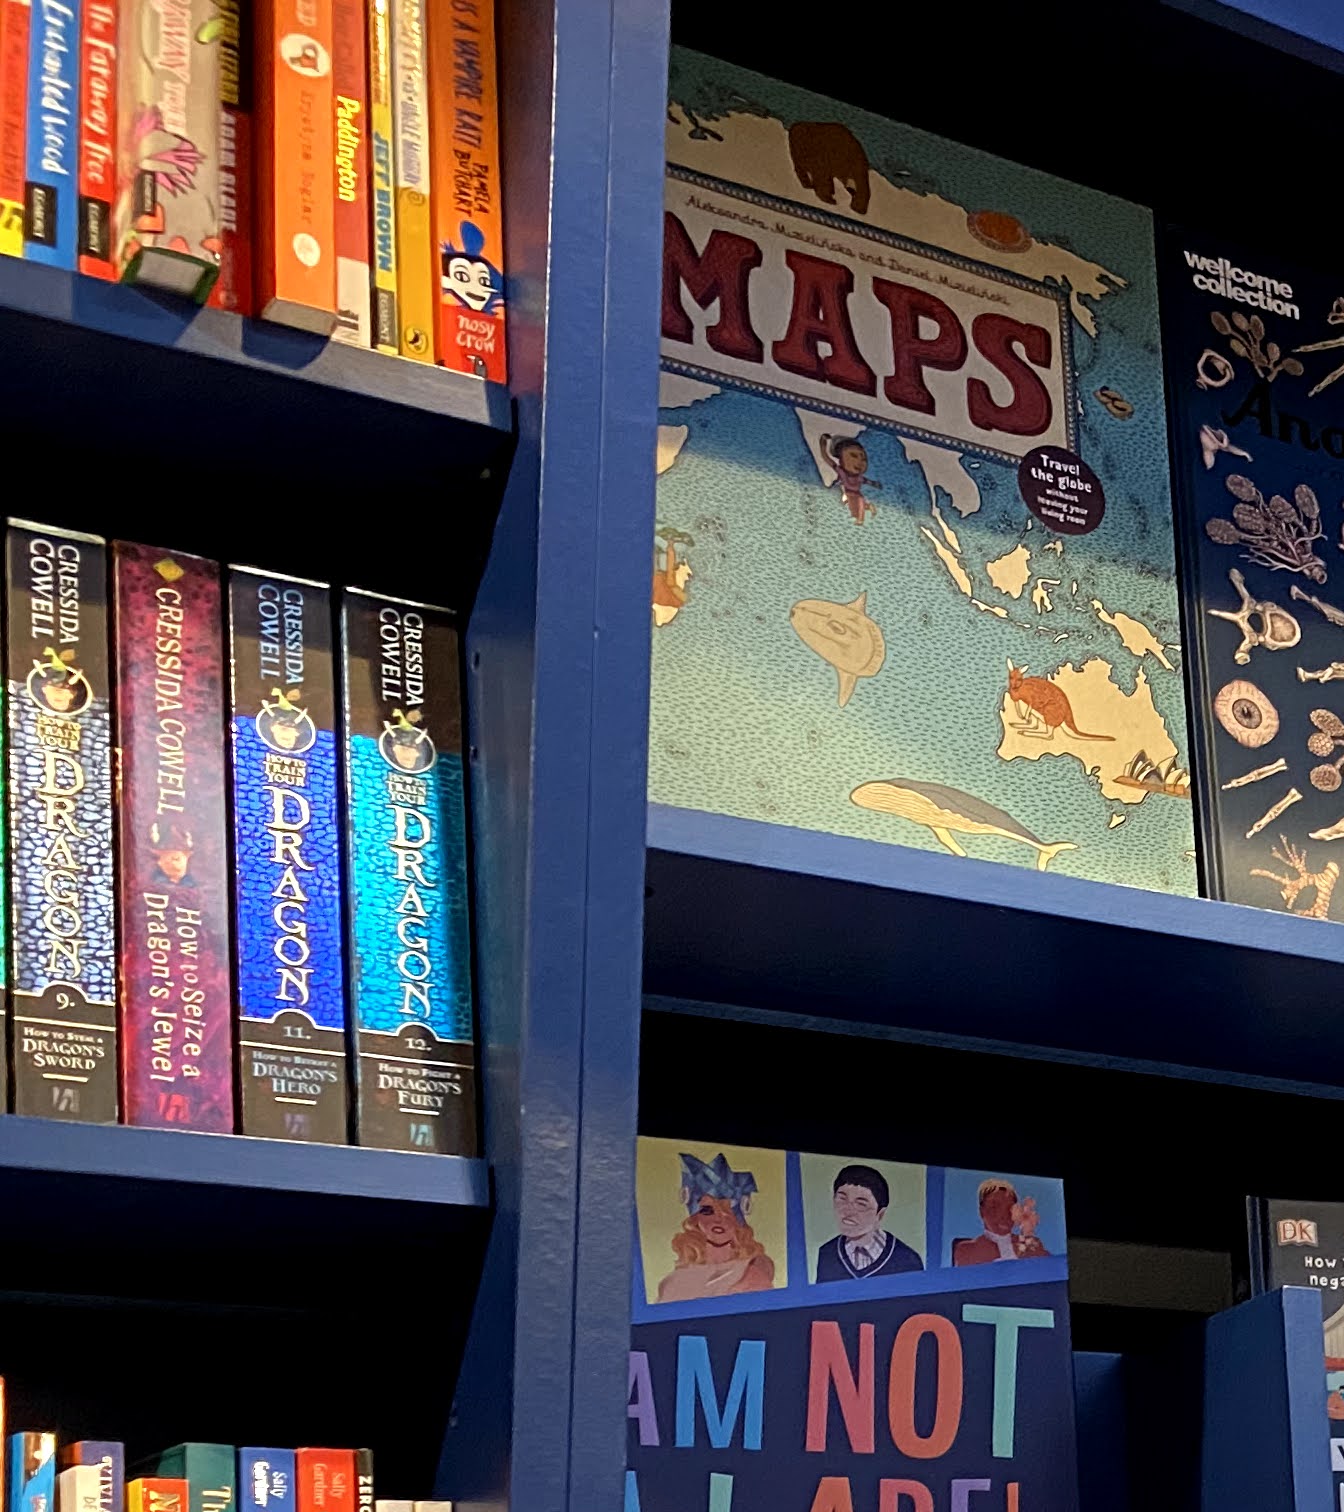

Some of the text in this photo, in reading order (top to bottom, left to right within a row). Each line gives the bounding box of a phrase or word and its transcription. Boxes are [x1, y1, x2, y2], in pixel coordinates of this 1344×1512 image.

[338, 94, 360, 203] Paddington
[454, 150, 472, 218] BUTCHART
[475, 162, 490, 217] PAMELA
[373, 130, 392, 273] JEFF BROWN
[661, 211, 1053, 436] MAPS
[1182, 248, 1293, 300] wellcome
[1192, 271, 1301, 321] collection
[1030, 468, 1092, 494] the globe
[1039, 454, 1081, 476] Travel
[28, 537, 55, 640] COWELL
[56, 544, 81, 646] CRESSIDA
[151, 587, 188, 817] CRESSIDA COWELL
[379, 605, 402, 703] COWELL
[403, 611, 426, 711] CRESSIDA
[38, 750, 86, 981] DRAGON
[264, 784, 315, 1010] DRAGON
[387, 804, 433, 1021] DRAGON
[174, 905, 202, 946] How
[142, 891, 176, 1084] Dragon's Jewel
[180, 981, 205, 1051] Seize
[182, 1060, 202, 1079] a
[804, 1303, 1055, 1462] NOT
